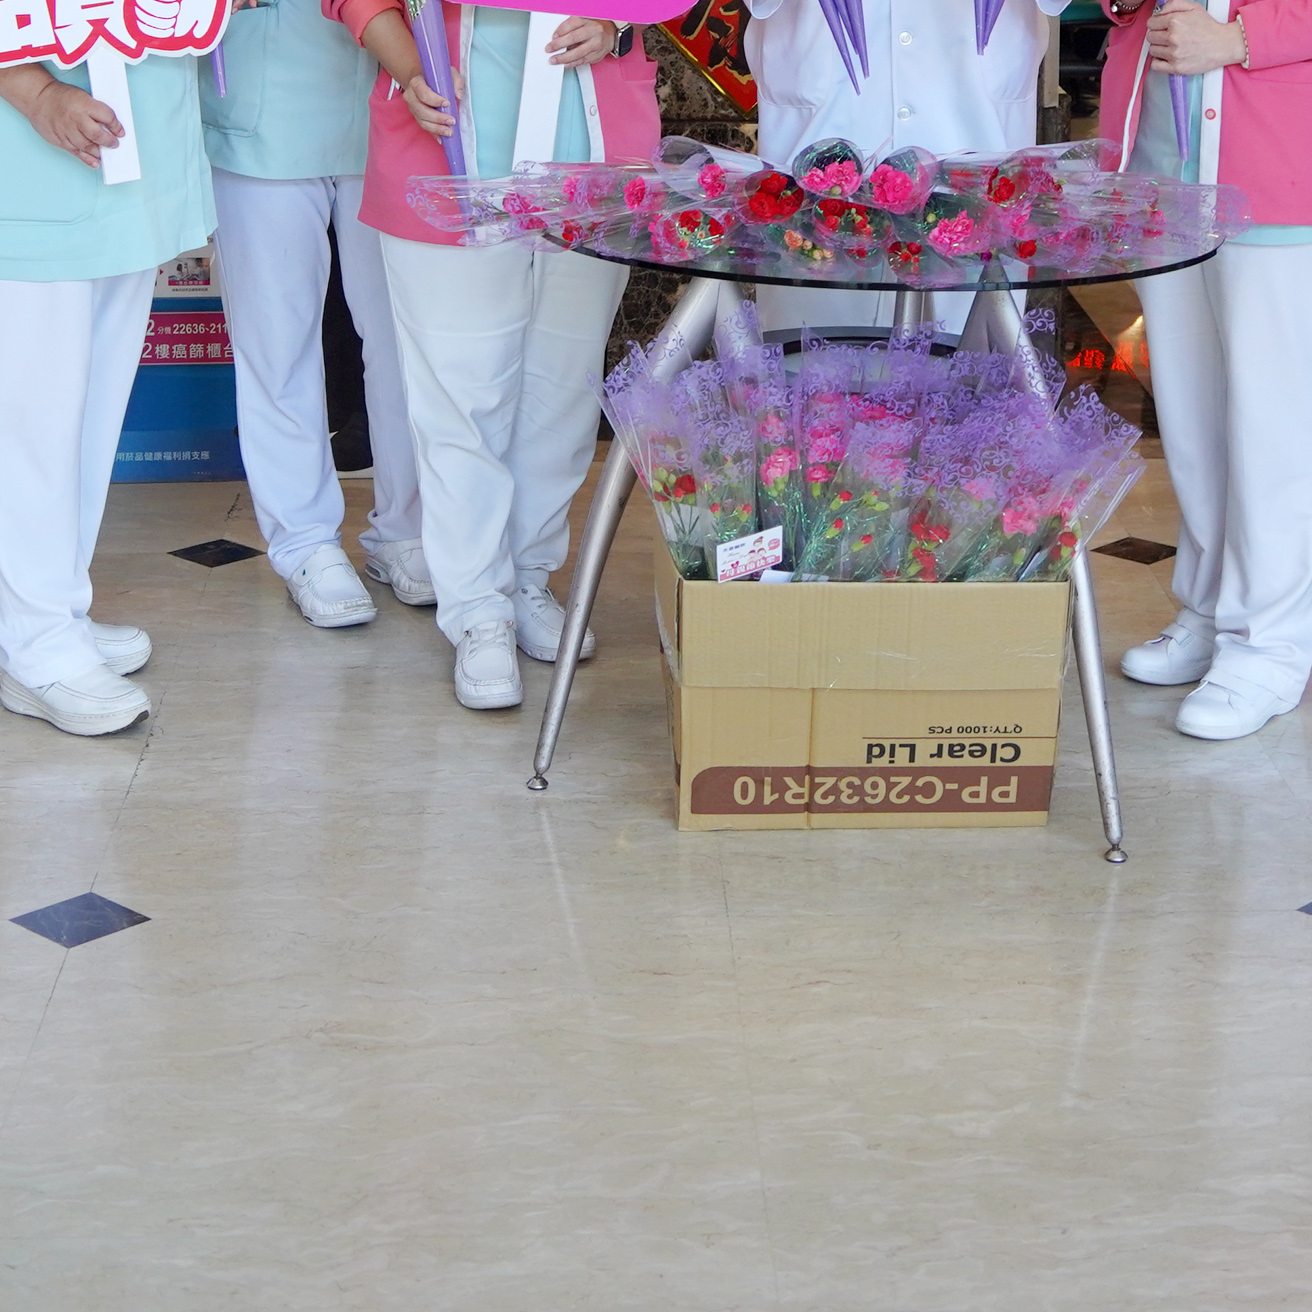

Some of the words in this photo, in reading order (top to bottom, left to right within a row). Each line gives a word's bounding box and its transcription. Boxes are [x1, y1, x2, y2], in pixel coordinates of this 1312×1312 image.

[927, 725, 955, 734] PCS
[865, 742, 917, 765] Lid
[929, 741, 1022, 764] Clear
[732, 775, 1019, 806] PP-C2632R10
